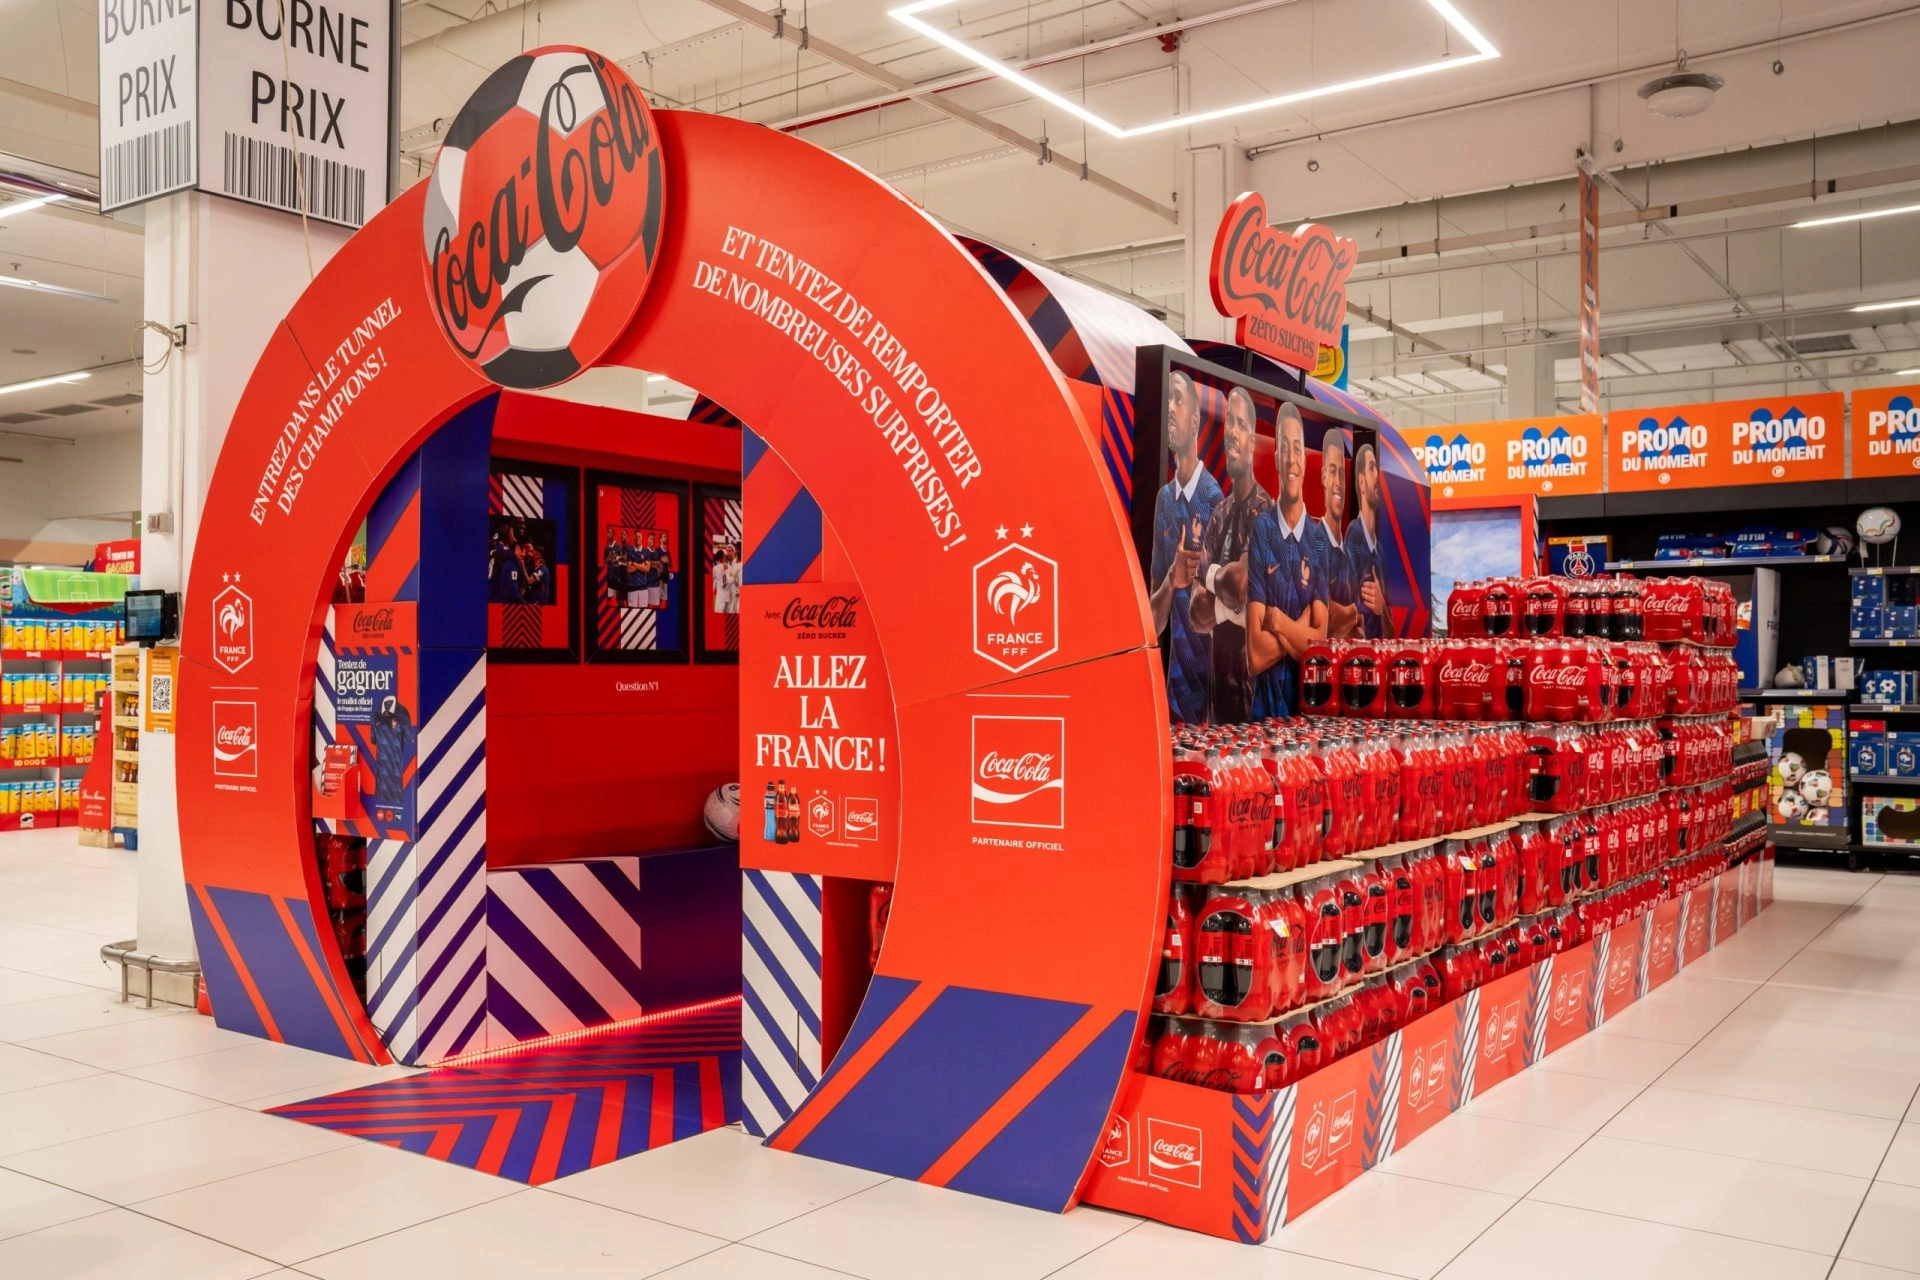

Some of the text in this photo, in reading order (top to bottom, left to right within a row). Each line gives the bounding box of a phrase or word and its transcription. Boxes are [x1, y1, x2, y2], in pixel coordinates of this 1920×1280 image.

[119, 54, 177, 127] PRIX
[251, 70, 345, 150] PRIX
[432, 52, 650, 360] Coca-Cola
[1223, 205, 1350, 334] Coca-Cola
[1250, 314, 1315, 359] zéro sucres
[720, 225, 982, 490] ET TENTEZ DE REMPORTER
[250, 297, 402, 526] ENTREZ DANS LE TUNNEL
[692, 260, 727, 296] DE
[724, 272, 873, 398] NOMBREUSES
[860, 385, 962, 539] SURPRISES
[277, 466, 304, 516] DES
[297, 353, 382, 471] CHAMPIONS
[1622, 425, 1708, 453] PROMO
[1732, 416, 1826, 446] PROMO
[1507, 435, 1588, 462] PROMO
[1732, 444, 1826, 464] DU MOMENT
[1869, 440, 1890, 456] DU
[1507, 461, 1588, 480] DU MOMENT
[1622, 452, 1708, 472] DU MOMENT
[1430, 468, 1486, 484] MOMENT
[106, 561, 135, 574] GAGNER
[765, 596, 861, 629] Avec Coca-Cola
[1643, 594, 1692, 612] Coca-Cola
[353, 608, 395, 633] Coca-Cola
[219, 646, 246, 655] FRANCE
[987, 632, 1043, 645] FRANCE
[358, 659, 367, 669] de
[773, 655, 867, 689] ALLEZ
[1440, 663, 1493, 683] Coca-Cola
[1529, 664, 1589, 686] Coca-Cola
[337, 670, 394, 696] gagner
[616, 681, 648, 692] Question
[800, 695, 840, 729] LA
[217, 725, 252, 746] Coca-Cola
[756, 733, 873, 772] FRANCE
[980, 751, 1056, 782] Coca-Cola
[847, 810, 875, 824] Coca-Cola
[971, 836, 1064, 852] PARTENAIRE OFFICIEL
[1153, 1139, 1198, 1161] Coca-Cola
